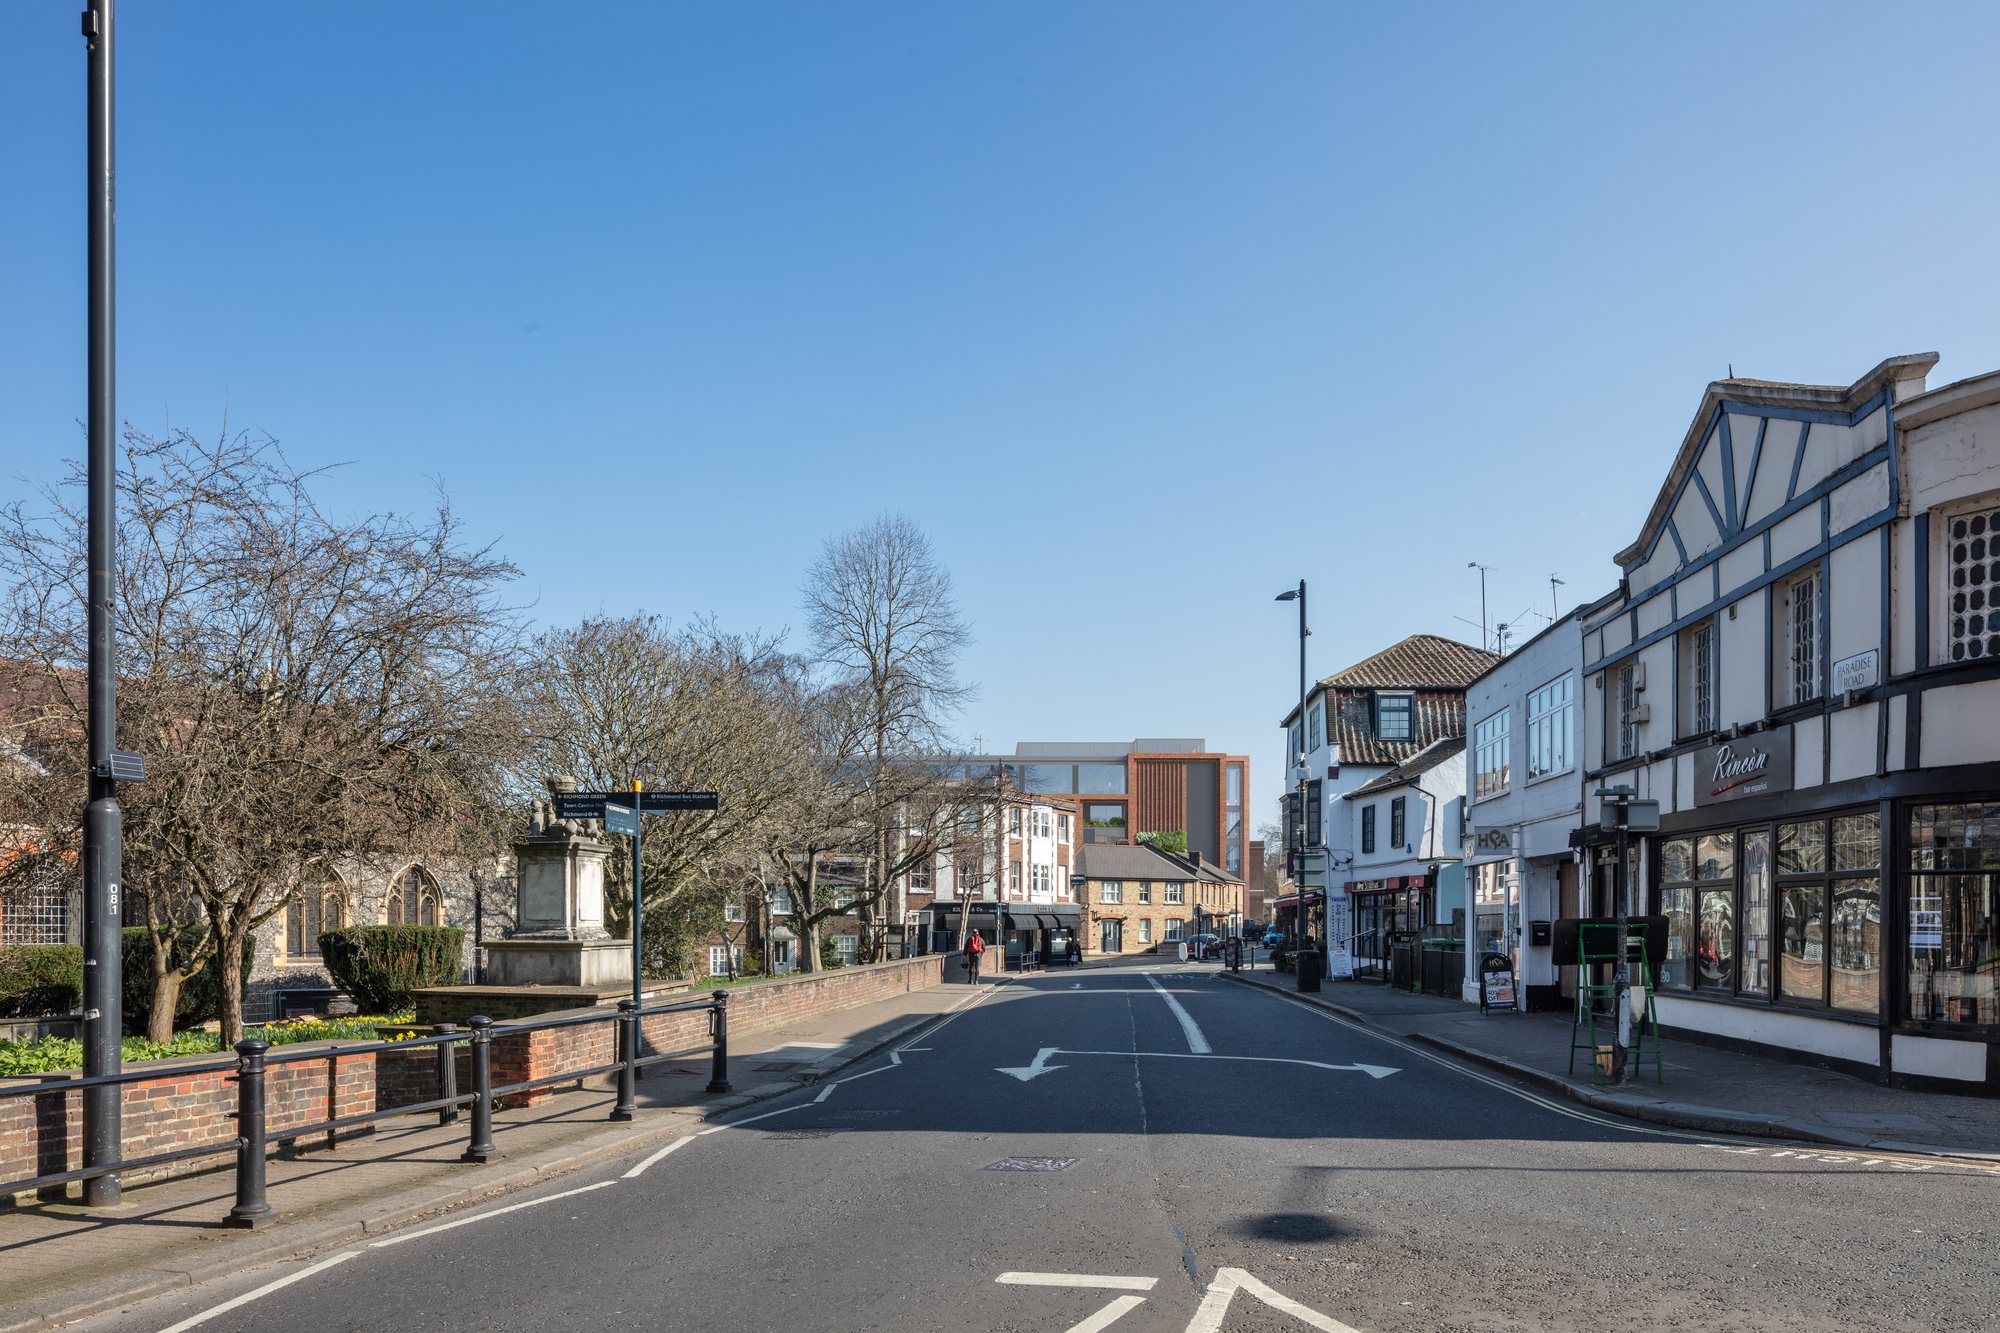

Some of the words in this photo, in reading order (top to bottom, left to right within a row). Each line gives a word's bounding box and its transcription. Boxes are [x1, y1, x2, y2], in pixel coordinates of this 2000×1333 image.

[1837, 655, 1872, 678] PARADISE
[1843, 673, 1865, 689] ROAD
[110, 884, 118, 914] 081
